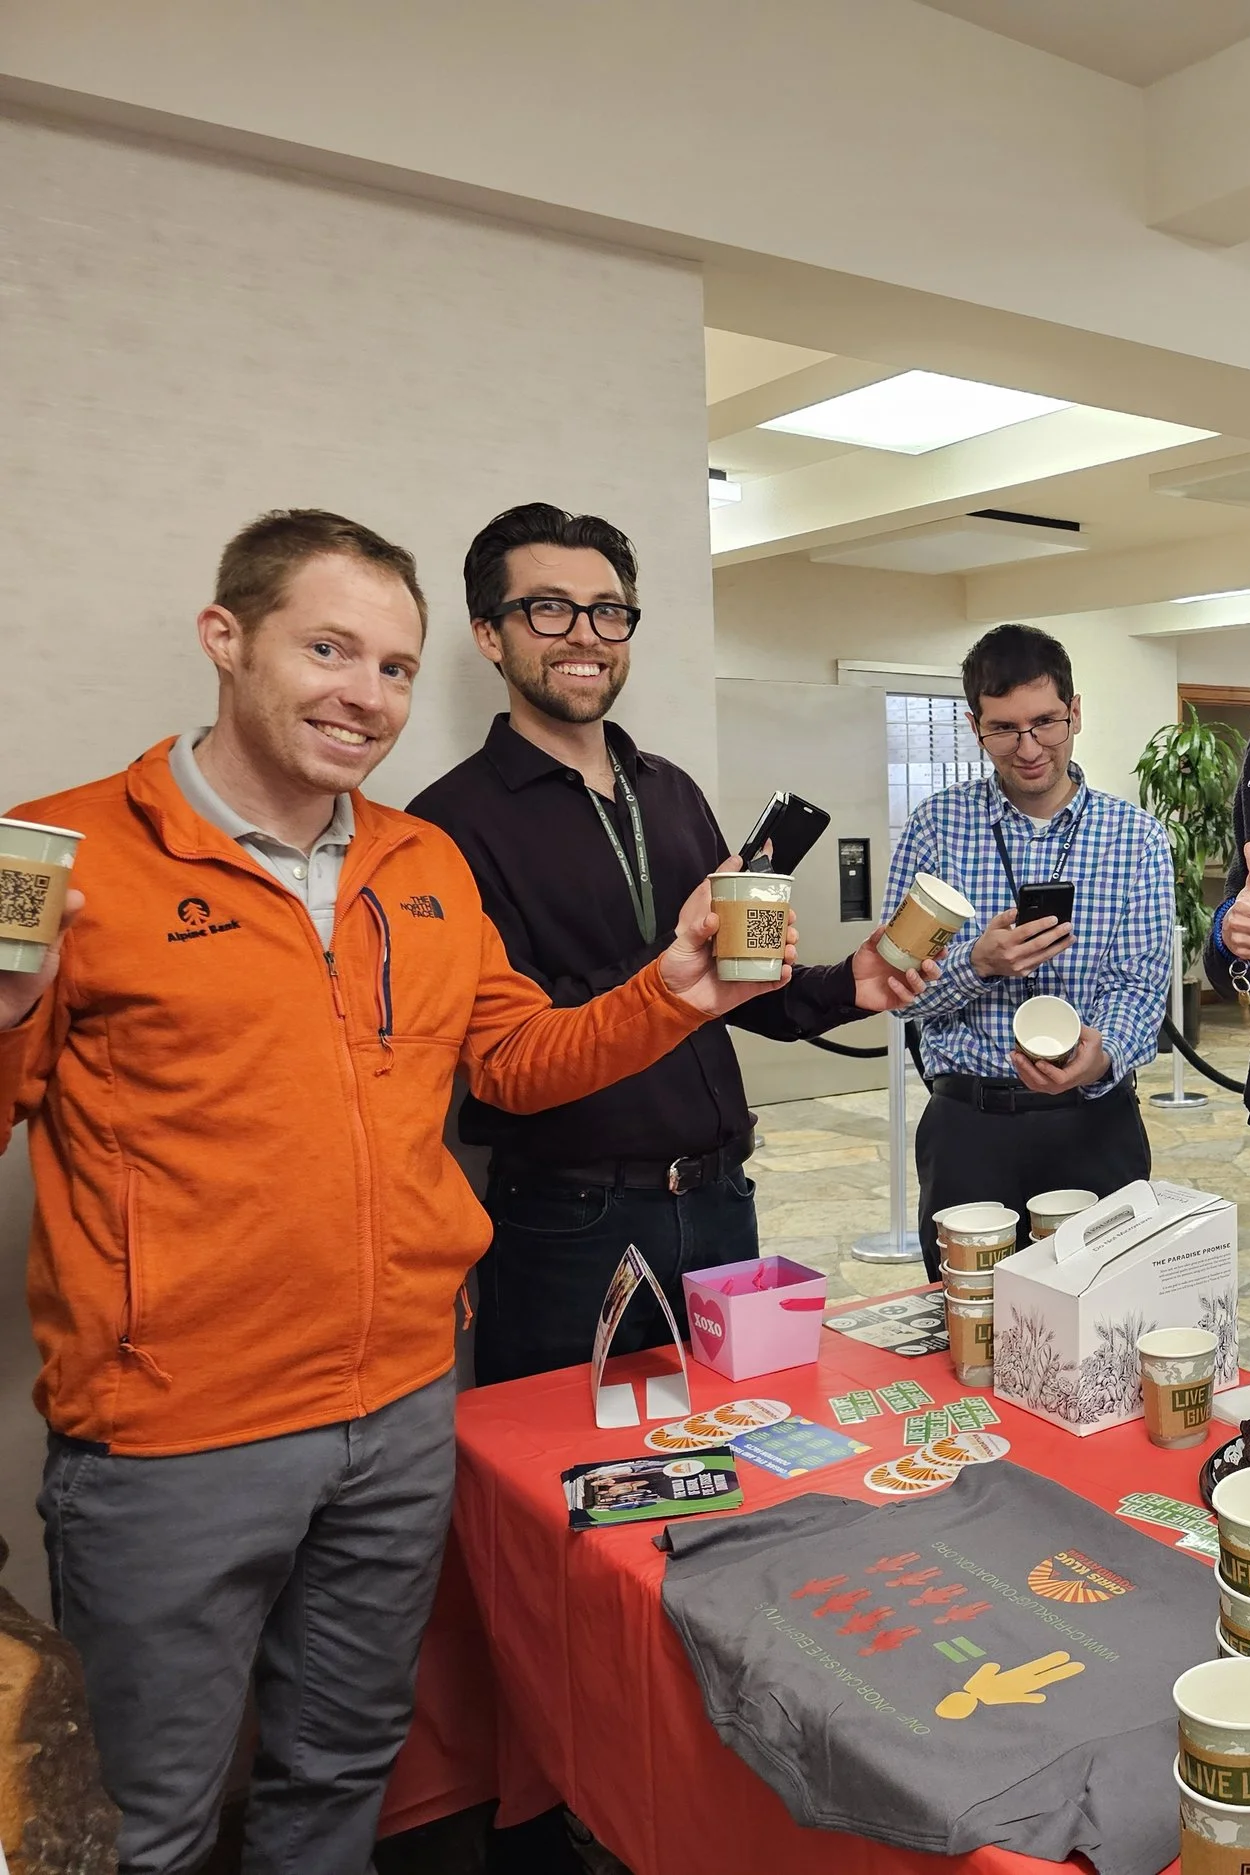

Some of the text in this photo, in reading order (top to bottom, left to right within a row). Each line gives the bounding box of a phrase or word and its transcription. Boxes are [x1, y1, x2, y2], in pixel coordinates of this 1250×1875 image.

[400, 903, 432, 912] NORTH
[167, 920, 242, 942] Alpine Bank
[1152, 1242, 1231, 1268] THE PARADISE PROMISE
[694, 1312, 722, 1338] XOXO
[1176, 1387, 1206, 1408] LIVE
[1188, 1405, 1211, 1426] GIVE
[1054, 1552, 1126, 1595] CHRIS KLUG
[1066, 1548, 1138, 1592] FOUNDATION
[931, 1541, 1121, 1663] WWW.CHRISKLUGFOUNDATION.ORG
[836, 1668, 863, 1687] CAN
[1184, 1760, 1234, 1799] LIVE
